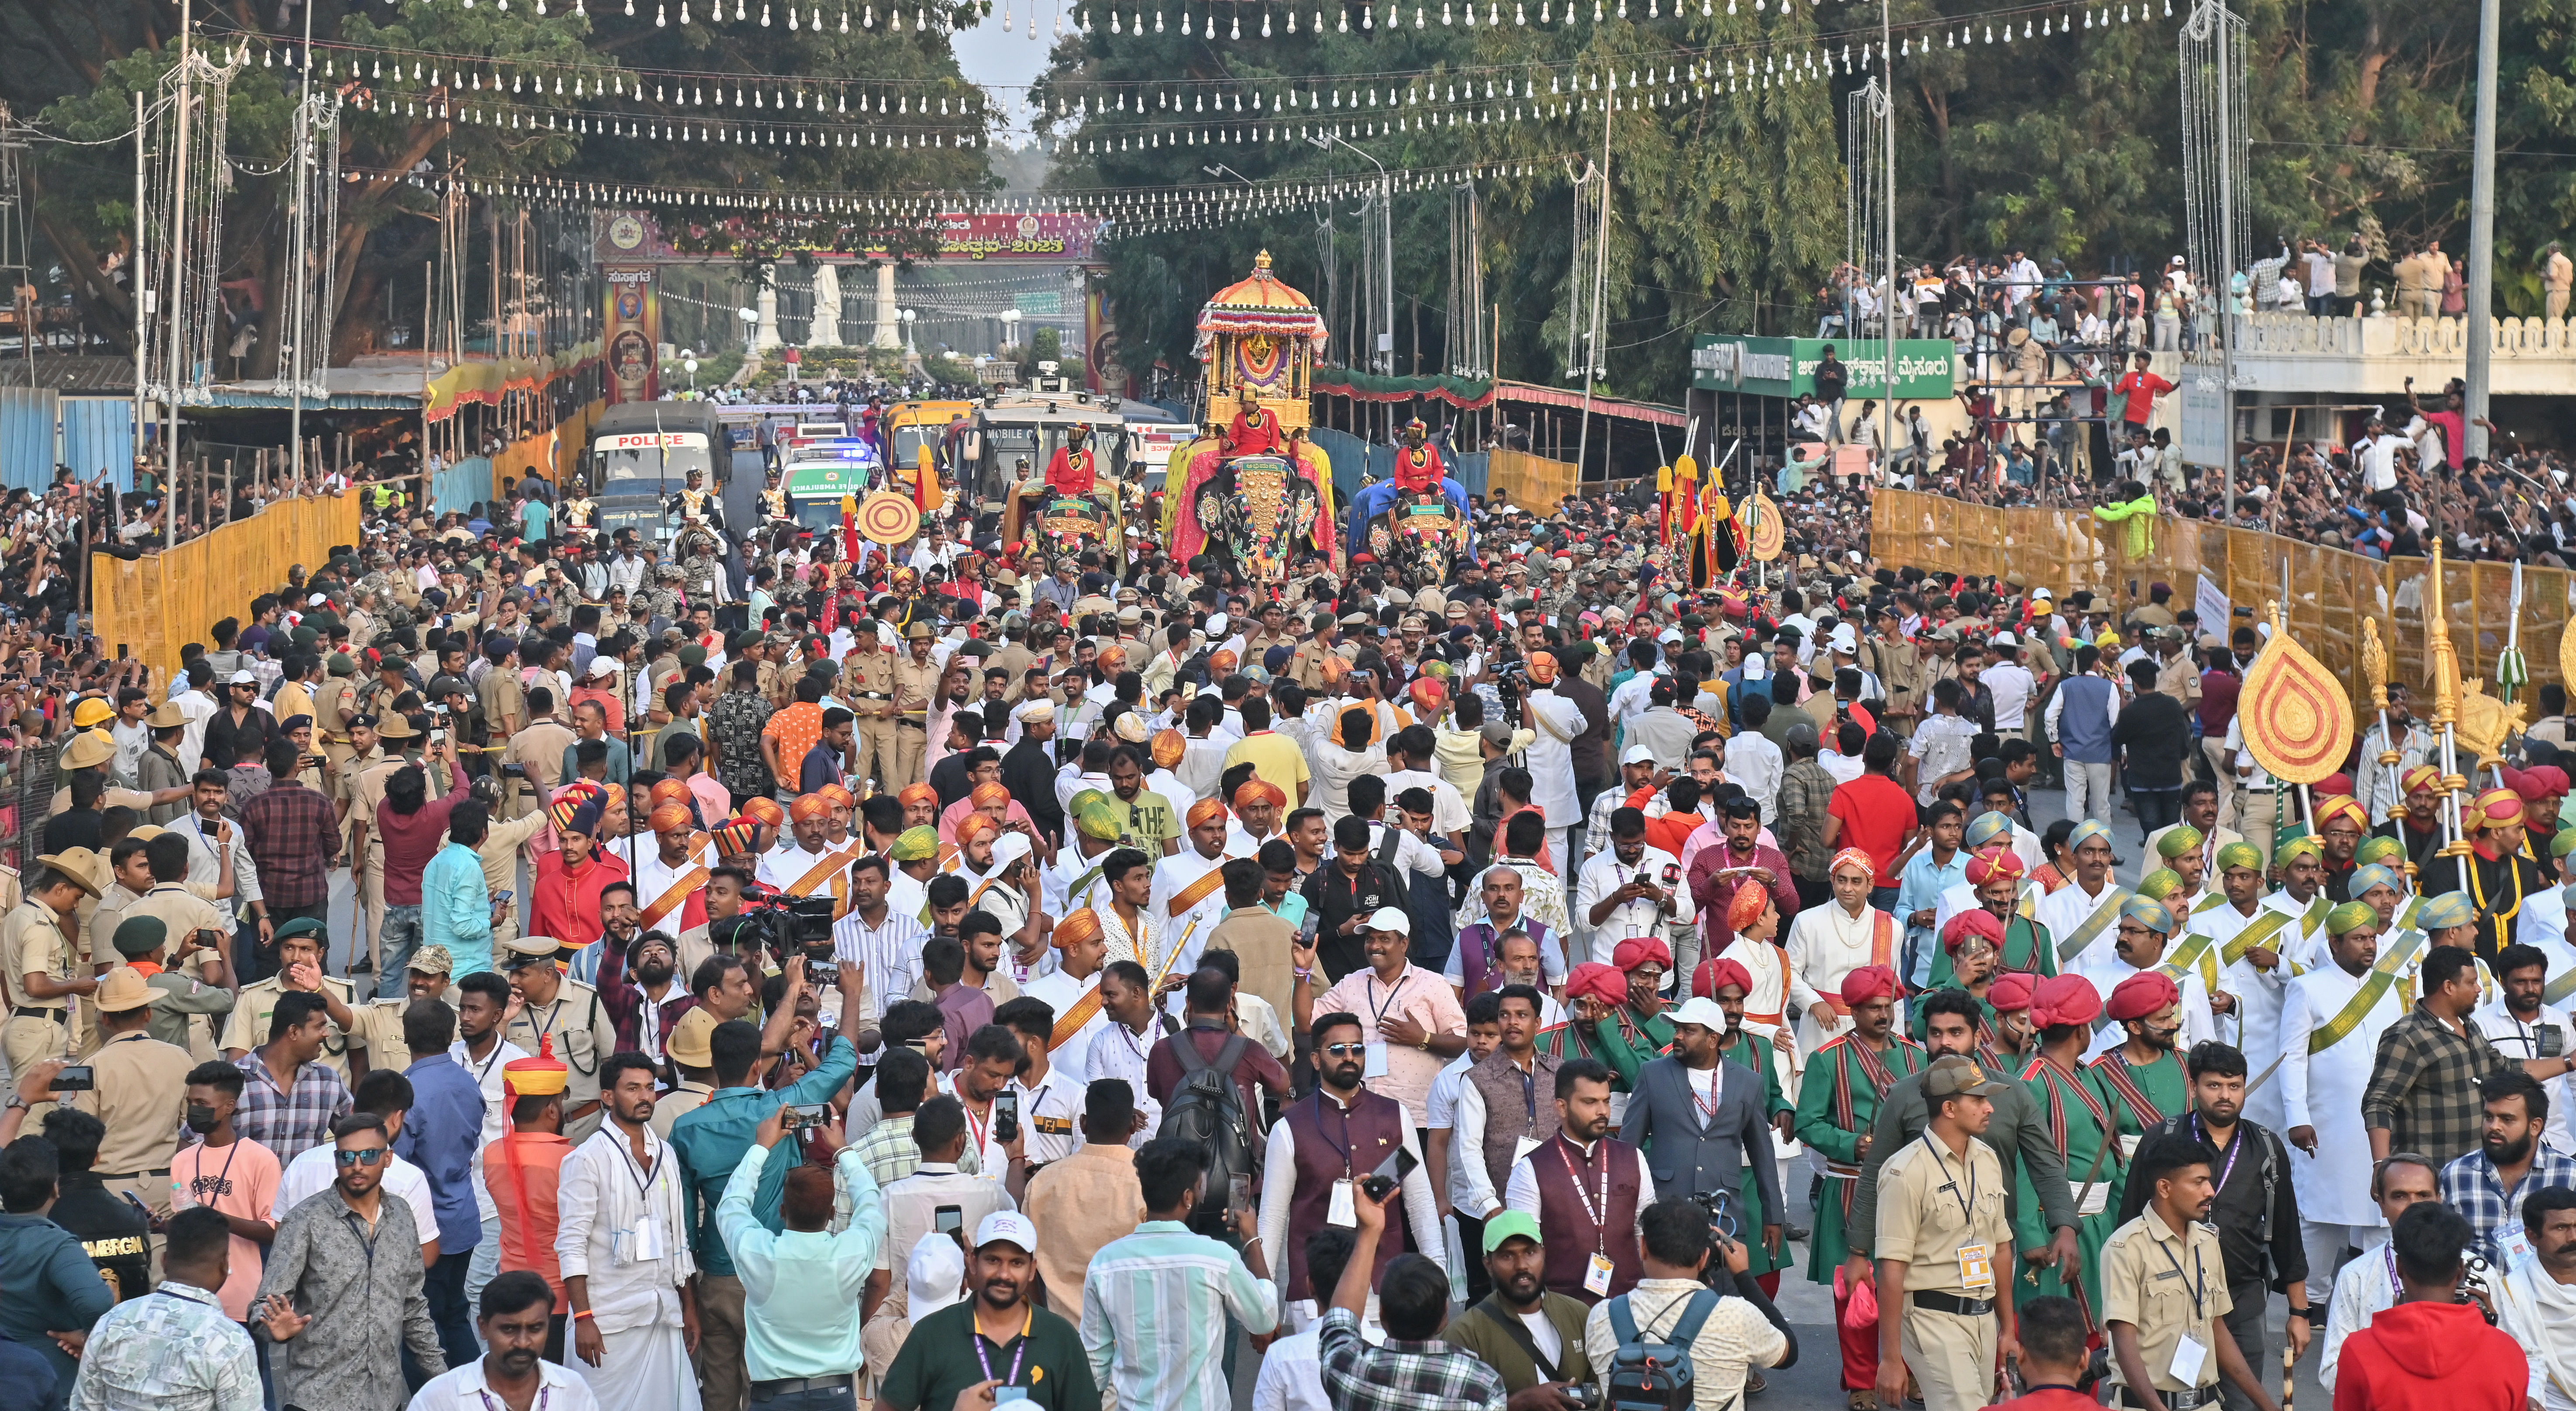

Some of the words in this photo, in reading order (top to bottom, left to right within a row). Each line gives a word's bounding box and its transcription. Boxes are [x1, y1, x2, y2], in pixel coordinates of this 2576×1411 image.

[608, 270, 651, 288] ಸುಸ್ವಾಗತ
[1898, 355, 1948, 383] ಮೈಸೂರು
[986, 429, 1022, 438] MOBILE
[1675, 869, 1681, 879] 18
